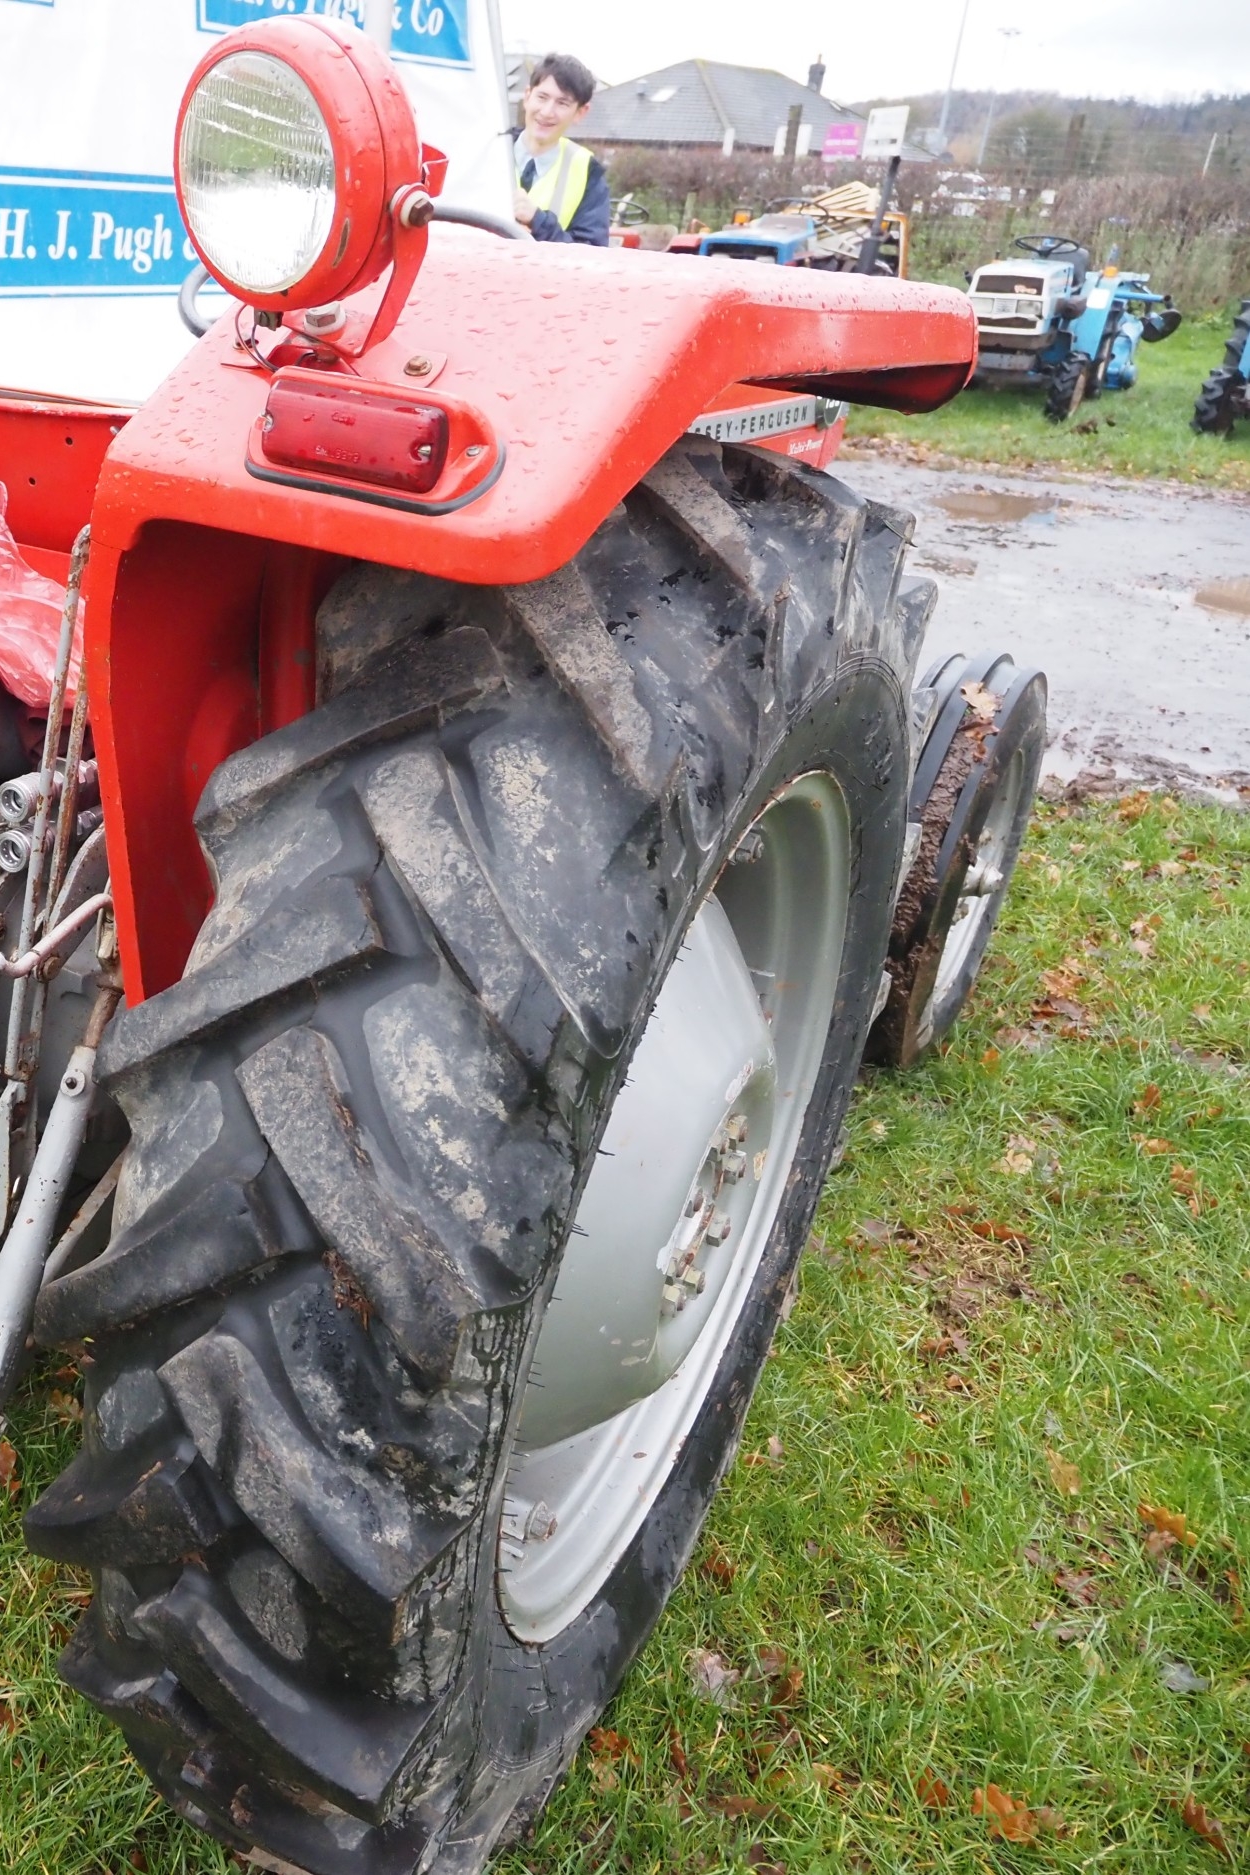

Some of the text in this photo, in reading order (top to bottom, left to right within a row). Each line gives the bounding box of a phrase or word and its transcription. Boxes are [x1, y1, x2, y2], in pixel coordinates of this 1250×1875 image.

[410, 0, 444, 36] Co
[47, 210, 78, 260] J.
[88, 211, 174, 274] Pugh
